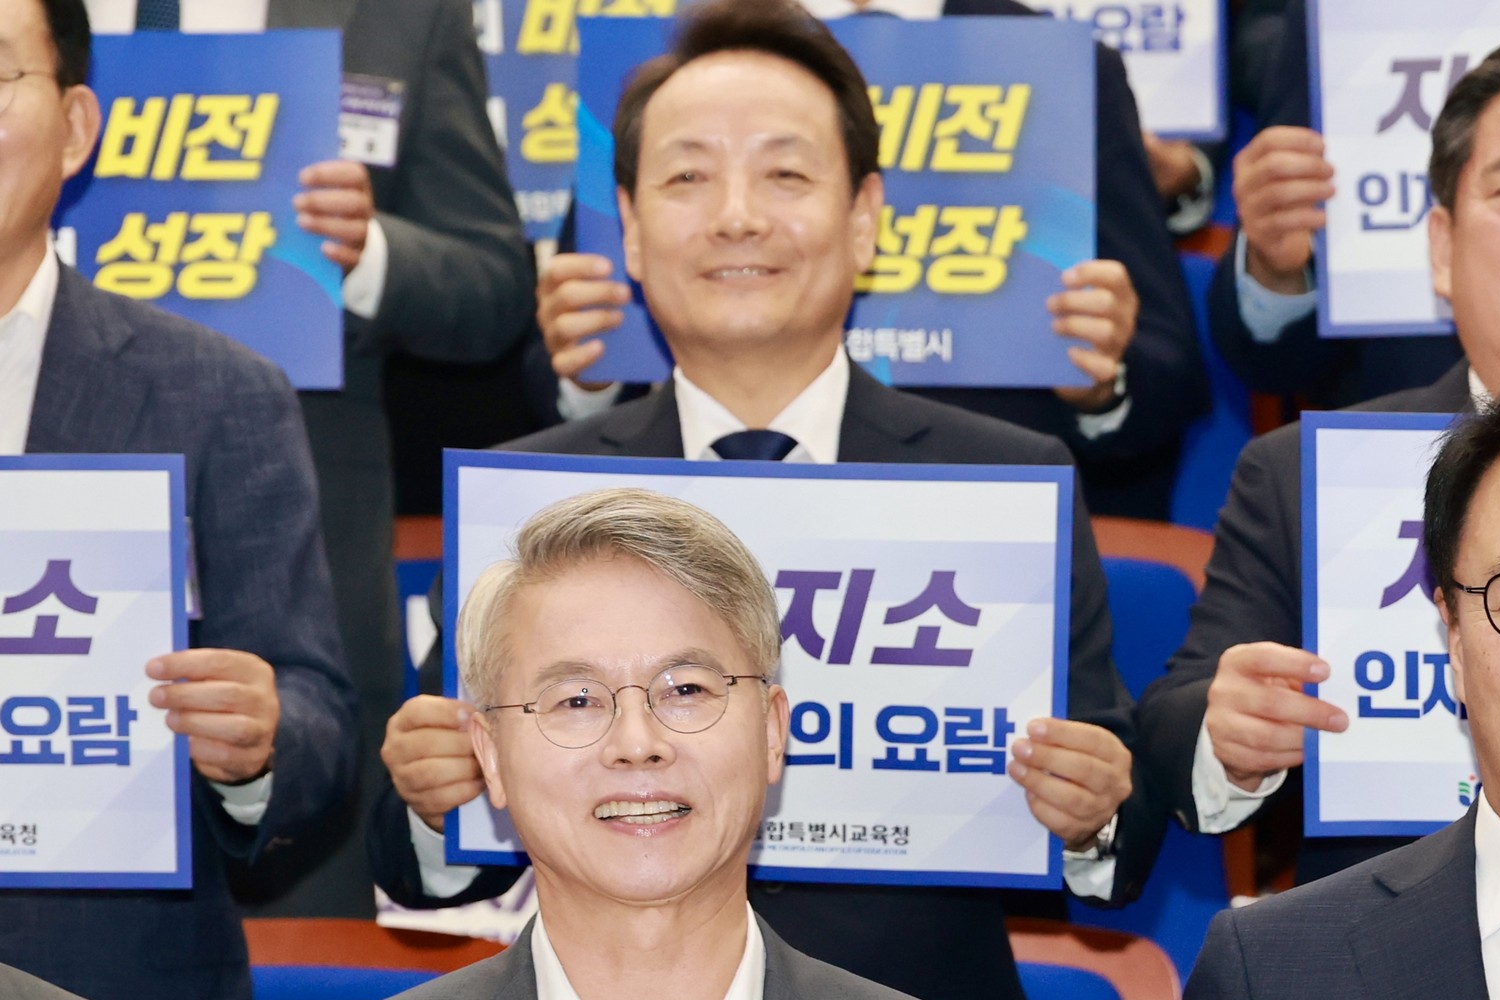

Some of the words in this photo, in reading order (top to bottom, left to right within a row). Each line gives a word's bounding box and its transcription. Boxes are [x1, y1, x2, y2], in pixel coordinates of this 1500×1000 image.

[94, 94, 279, 181] 비전
[94, 211, 277, 299] 성장
[855, 204, 1028, 294] 성장
[774, 568, 981, 668] 지소
[0, 695, 138, 767] 요람
[872, 705, 1015, 775] 요람
[766, 821, 909, 846] 합특별시교육청
